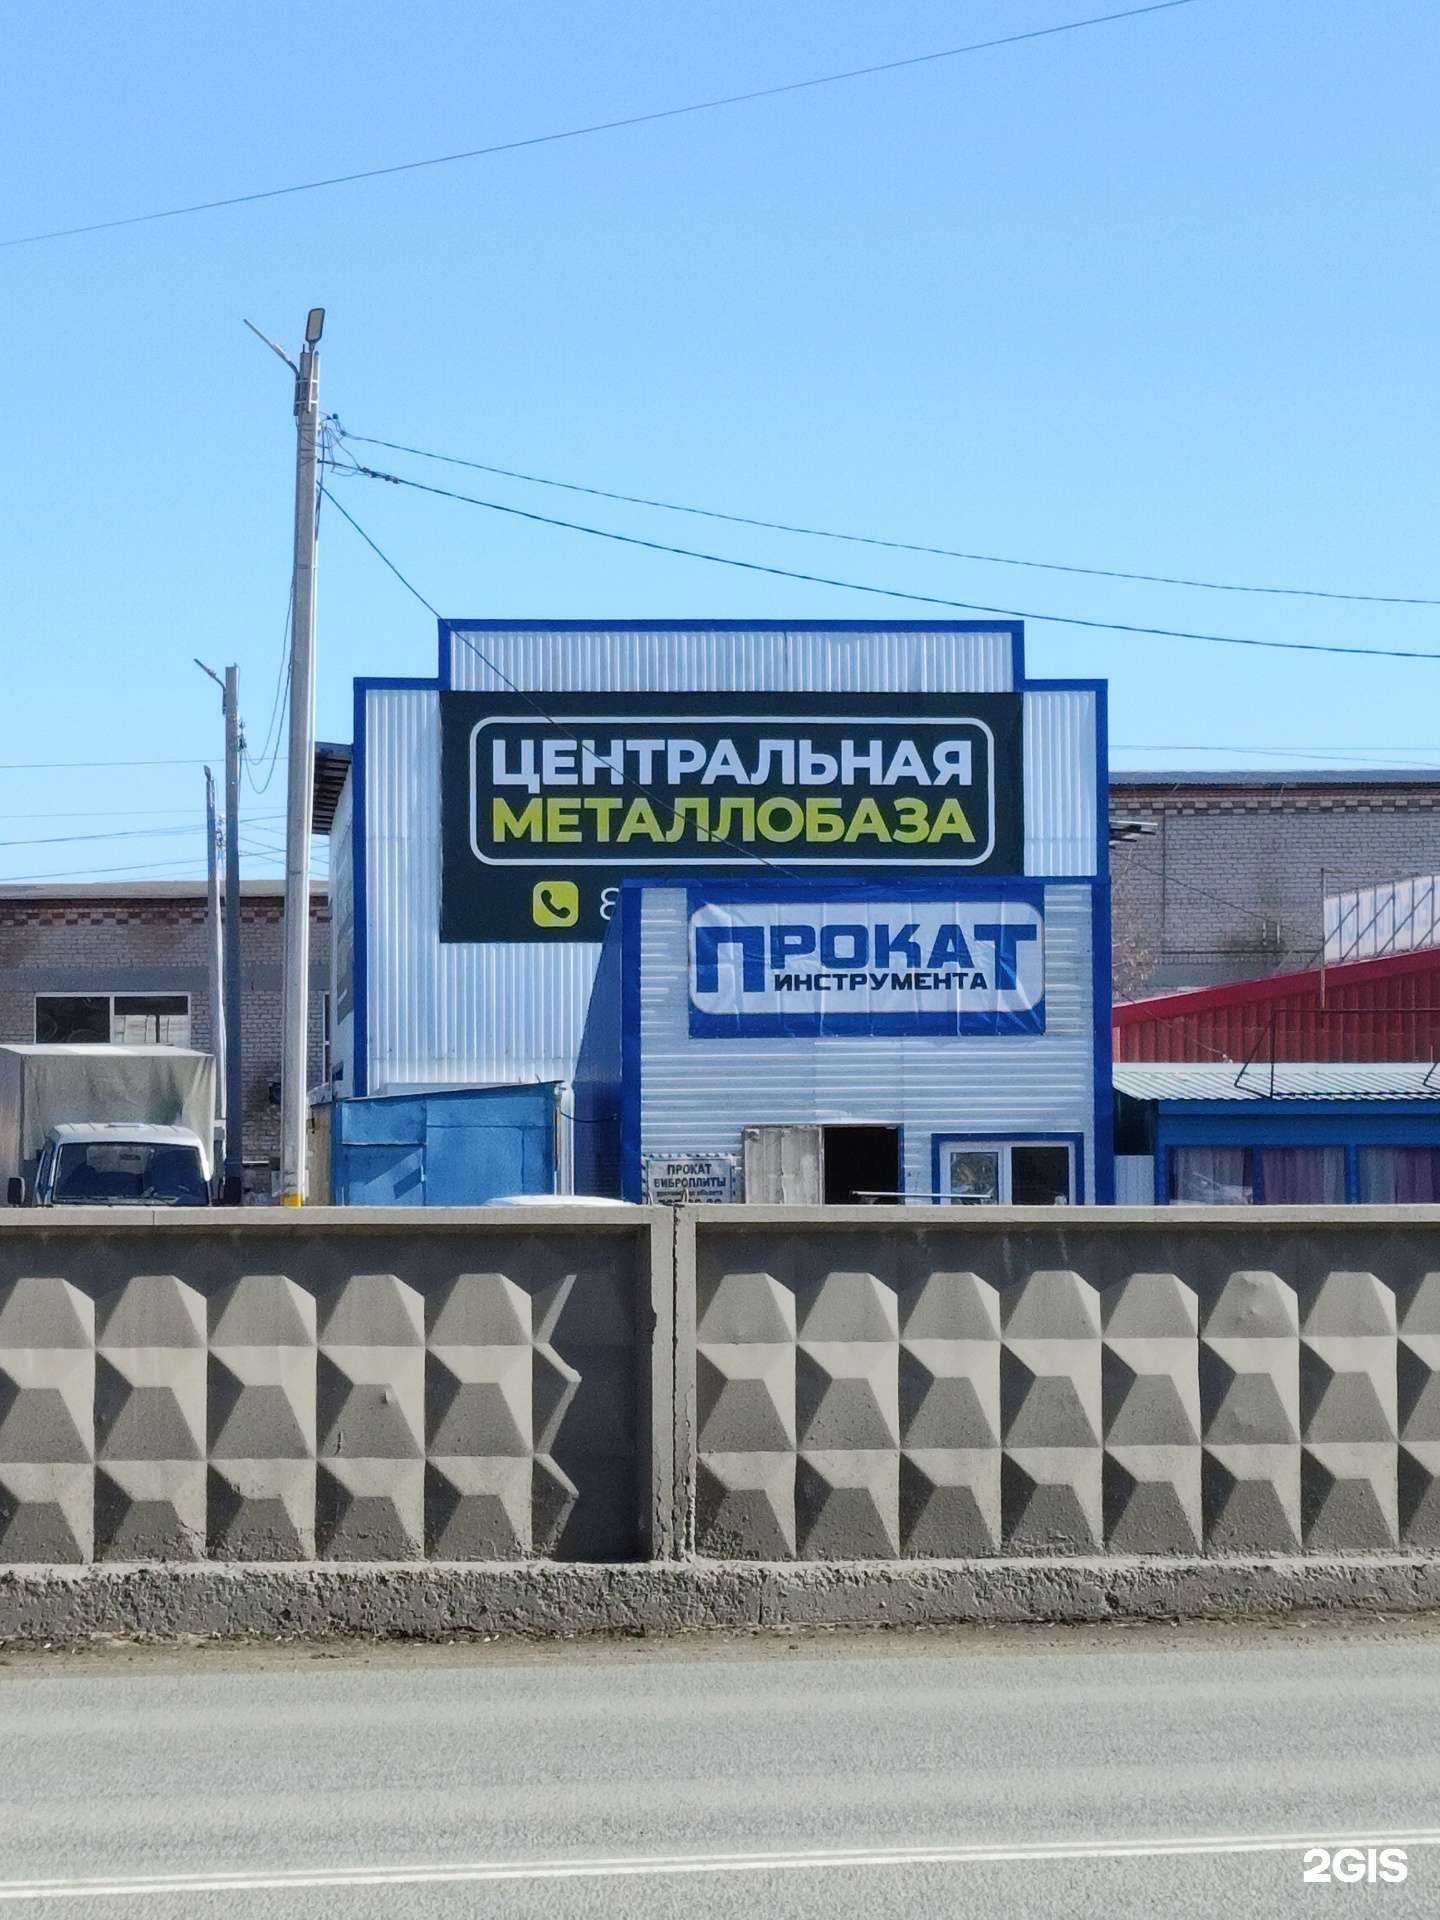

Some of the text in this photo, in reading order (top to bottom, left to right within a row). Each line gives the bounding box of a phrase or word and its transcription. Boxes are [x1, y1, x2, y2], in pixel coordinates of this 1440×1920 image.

[493, 739, 973, 794] ЦЕНТРАЛЬНАЯ
[493, 797, 976, 843] МЕТАЛЛОБАЗА
[695, 924, 1038, 993] ПРОКАТ
[774, 972, 988, 992] ИНСТРУМЕНТА
[654, 1177, 727, 1188] ВИБРОПЛИТЫ
[667, 1163, 713, 1175] ПРОКАТ
